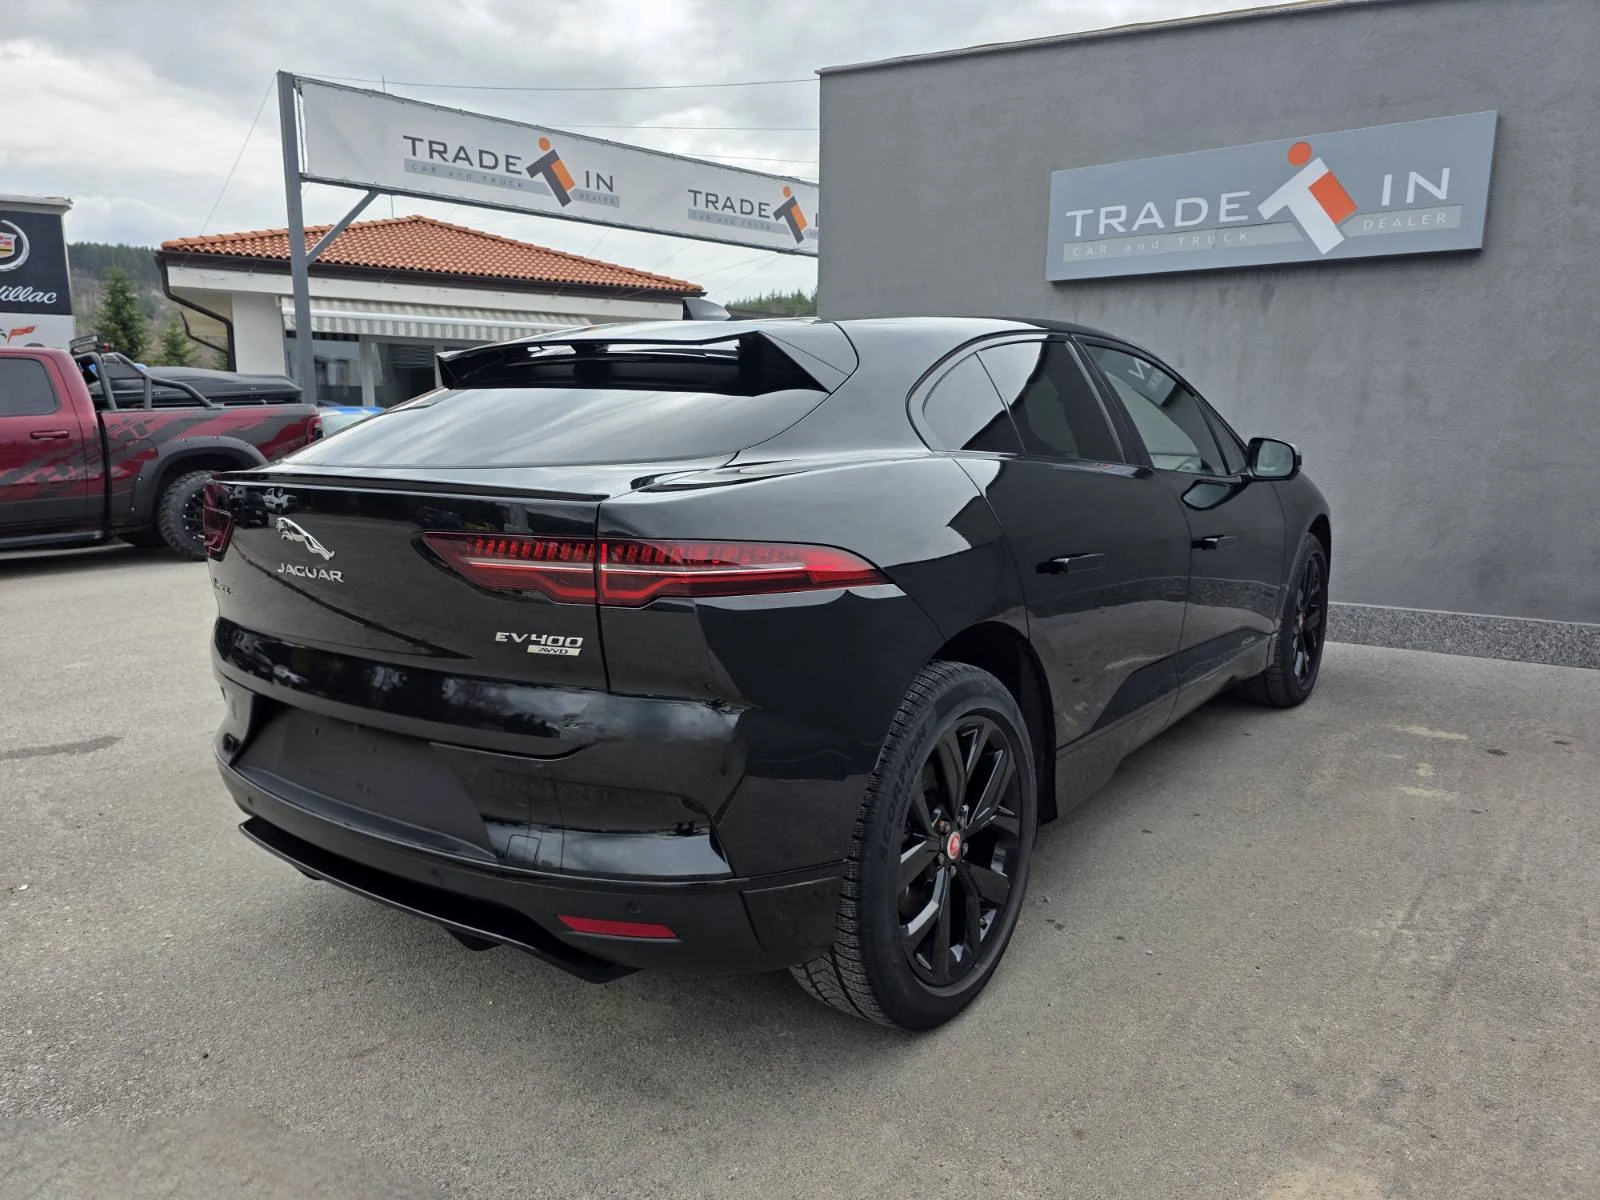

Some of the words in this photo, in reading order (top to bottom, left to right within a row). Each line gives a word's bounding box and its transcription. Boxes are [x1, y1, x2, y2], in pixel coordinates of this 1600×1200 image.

[402, 135, 523, 175] TRADE
[585, 170, 614, 193] IN
[687, 188, 770, 219] TRADE
[1065, 190, 1250, 237] TRADE
[1381, 167, 1450, 206] IN
[1072, 244, 1107, 257] CAR
[1125, 239, 1159, 253] and
[1177, 231, 1249, 249] TRUCK
[1363, 212, 1447, 231] DEALER
[277, 562, 345, 583] JAGUAR
[495, 631, 584, 648] EV400
[539, 647, 569, 655] AWD
